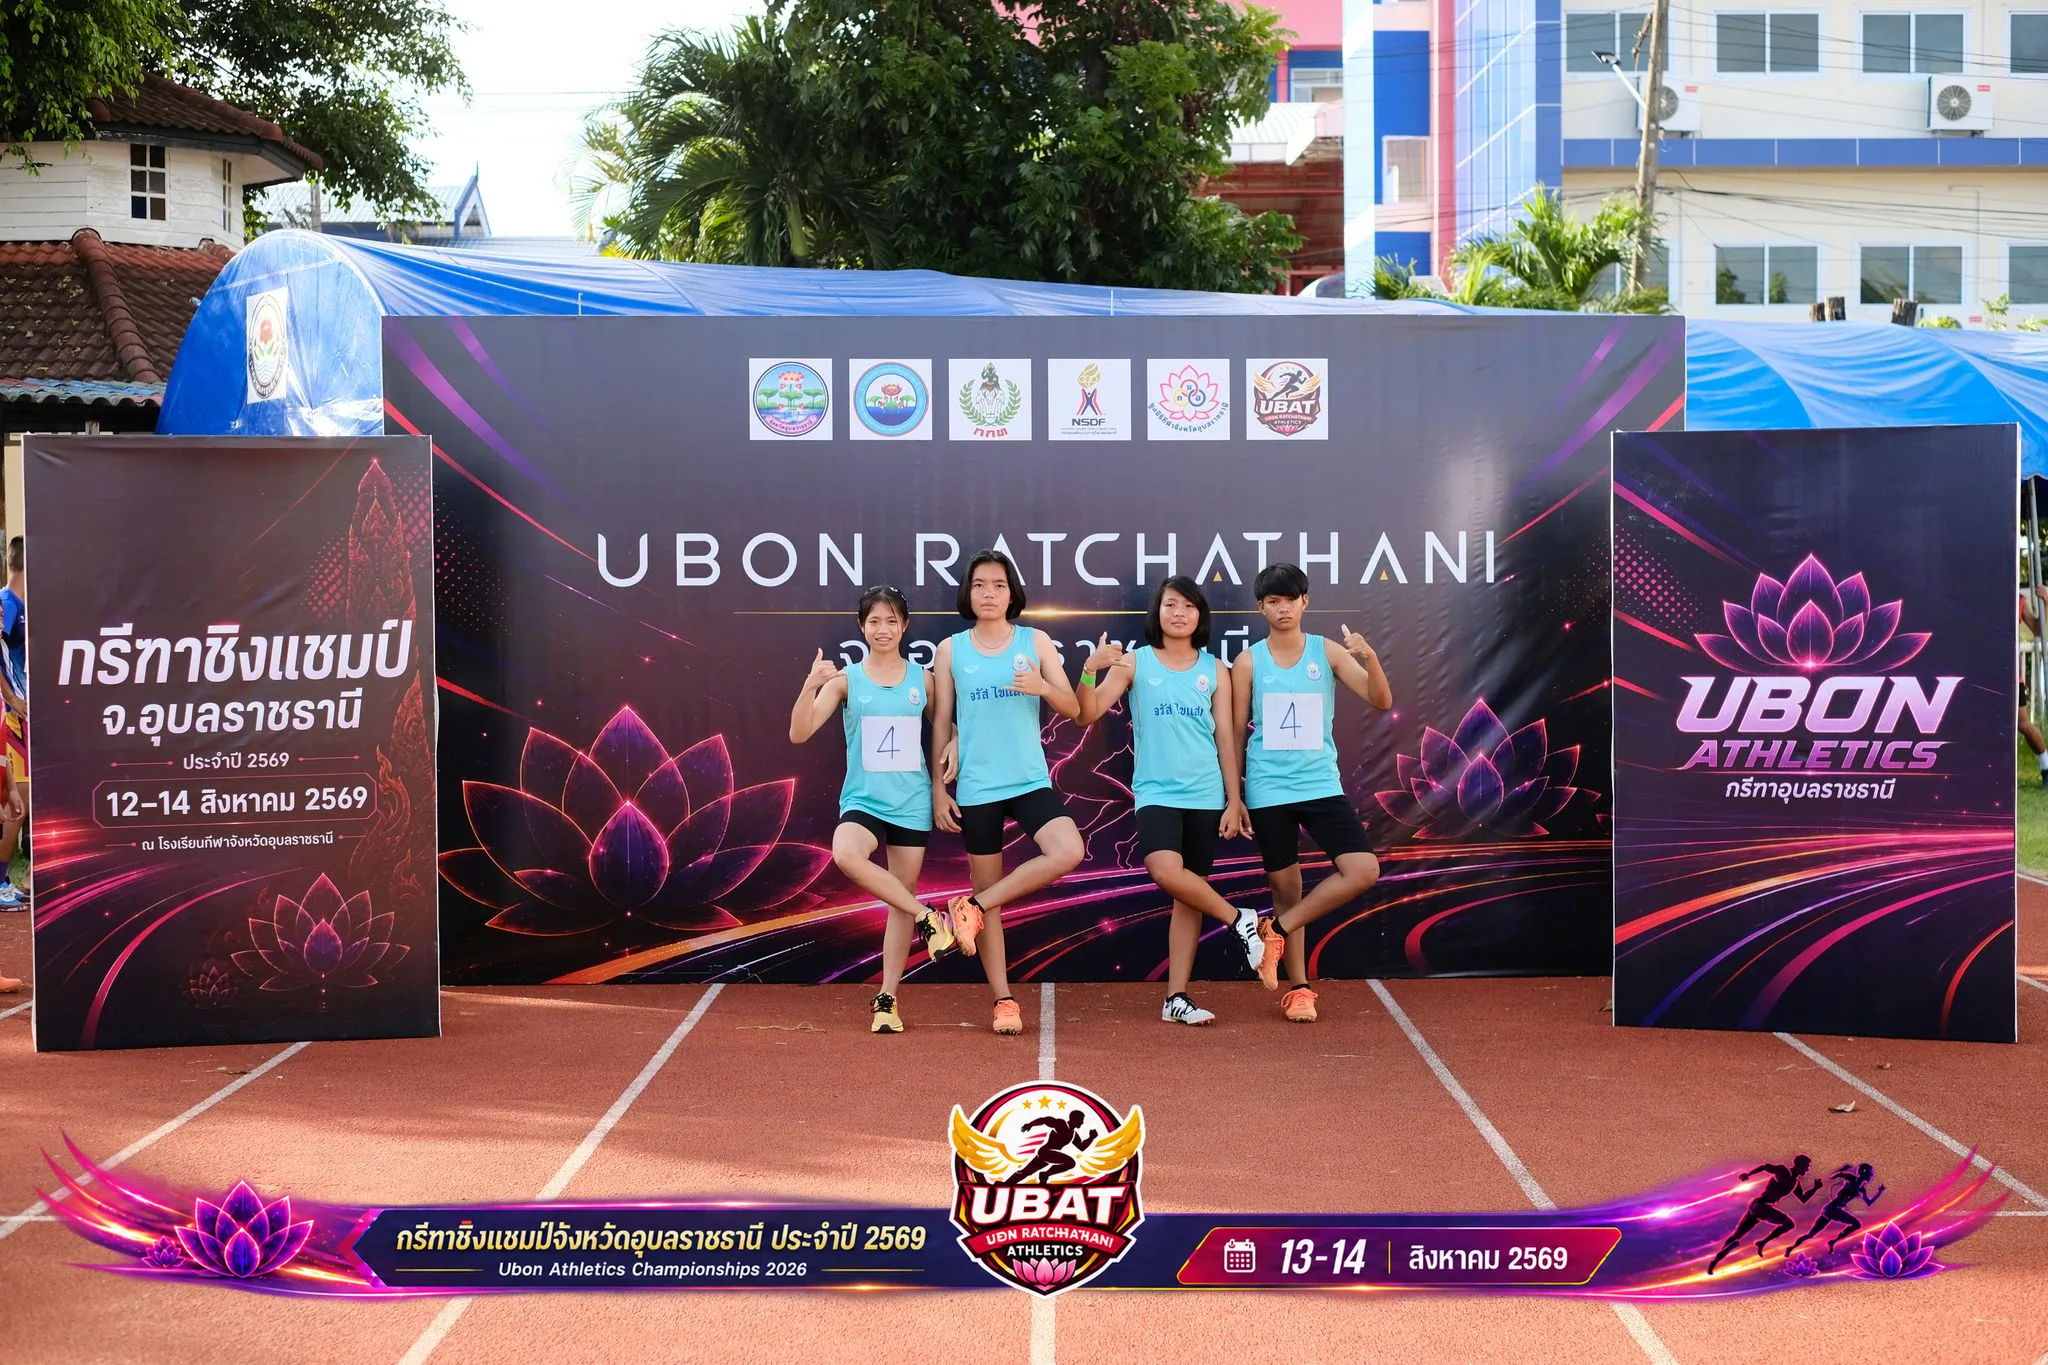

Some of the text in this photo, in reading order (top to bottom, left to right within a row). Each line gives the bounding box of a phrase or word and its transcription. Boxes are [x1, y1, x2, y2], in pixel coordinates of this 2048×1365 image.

[1072, 418, 1106, 426] NSDF
[1260, 400, 1316, 415] UBAT
[597, 530, 1497, 588] UBON RATCHATHANI
[58, 619, 412, 686] กรีฑาชิงแชมป์
[102, 688, 363, 747] จ.อุบลราชธานี
[1280, 701, 1302, 739] 4
[1676, 676, 1965, 734] UBON
[877, 725, 901, 759] 4
[1676, 740, 1950, 770] ATHLETICS
[183, 751, 290, 770] ประจำปี 2569
[106, 786, 368, 817] 12-14 สิงหาคม 2569
[1725, 777, 1896, 804] กรีฑาอุบลราชธานี
[142, 831, 333, 850] ณ โรงเรียนกีฬาจังหวัดอุบลราชธานี
